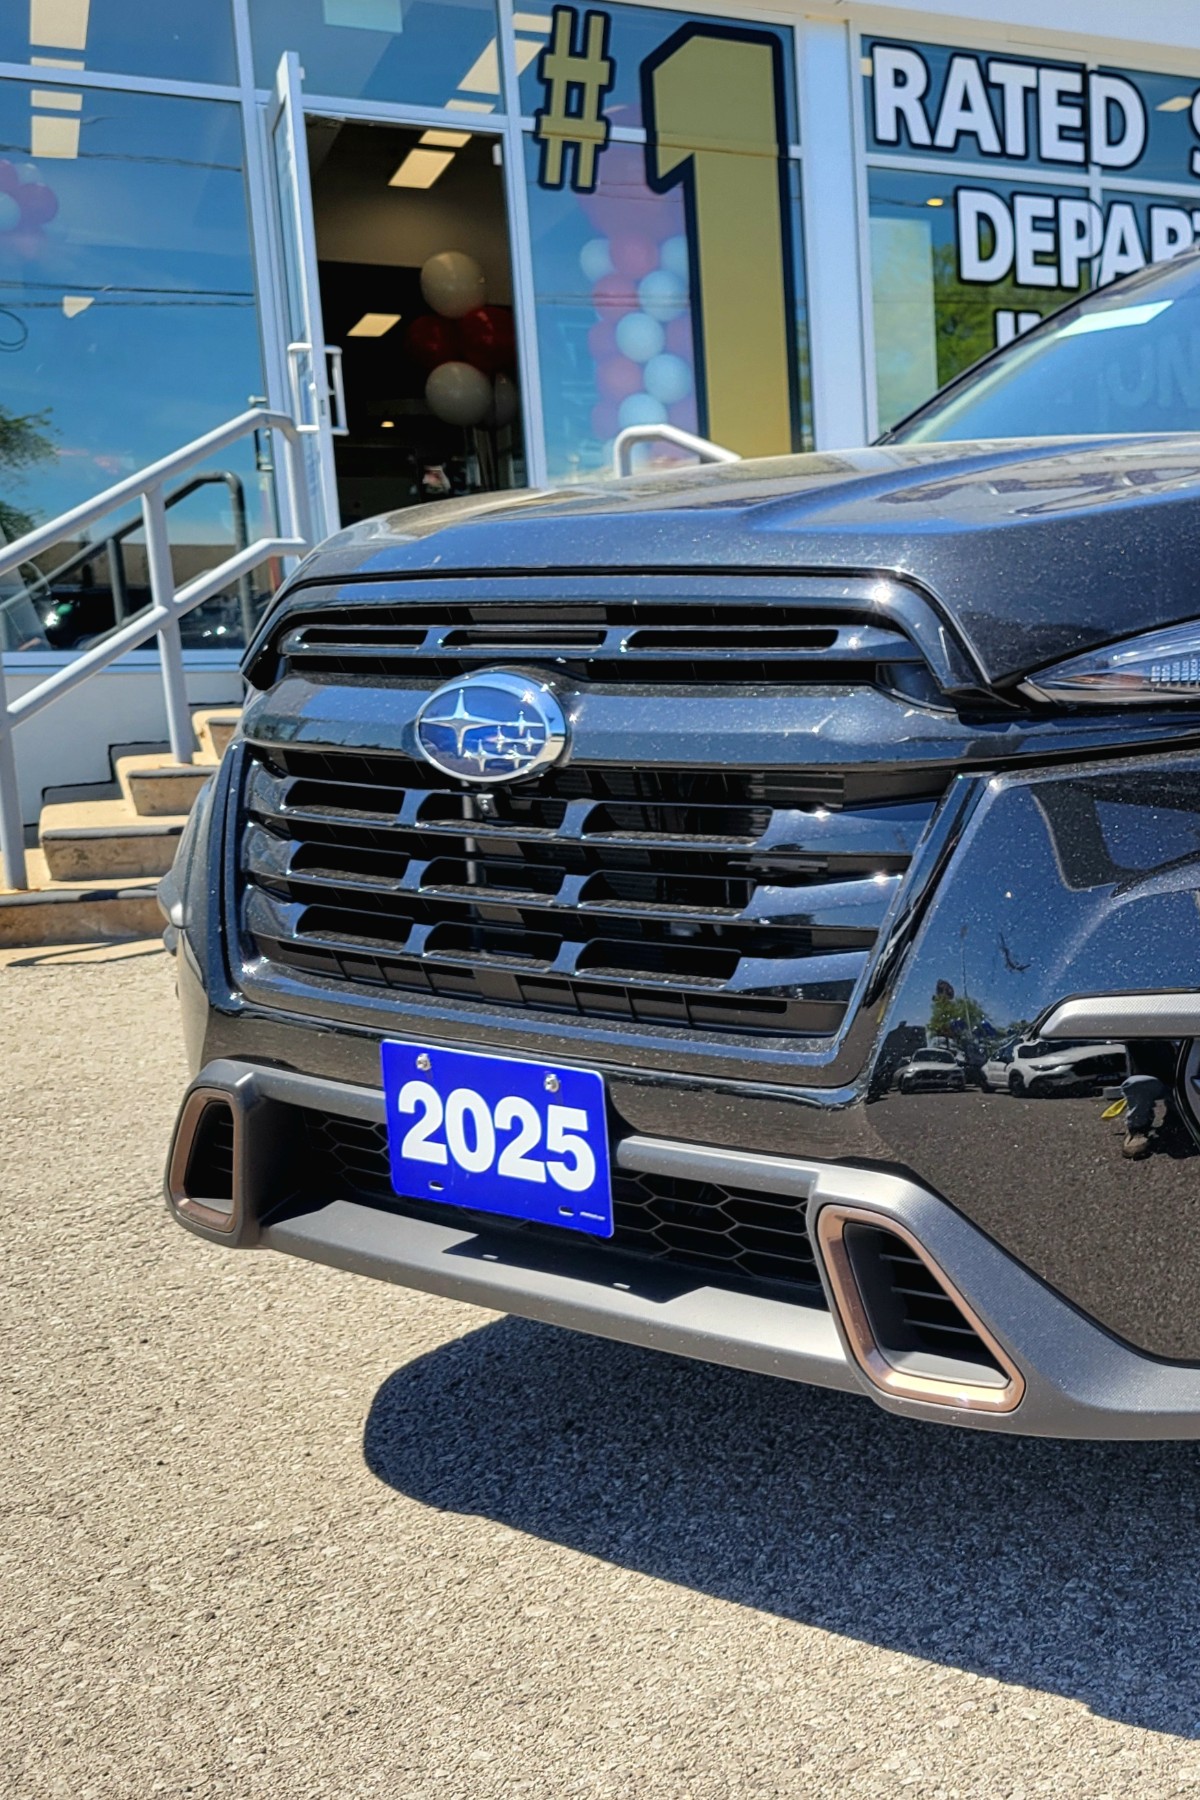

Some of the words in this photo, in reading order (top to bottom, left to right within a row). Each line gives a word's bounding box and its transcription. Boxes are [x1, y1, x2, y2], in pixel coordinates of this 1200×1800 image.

[535, 6, 799, 456] #1
[871, 43, 1147, 169] RATED
[397, 1080, 597, 1193] 2025
